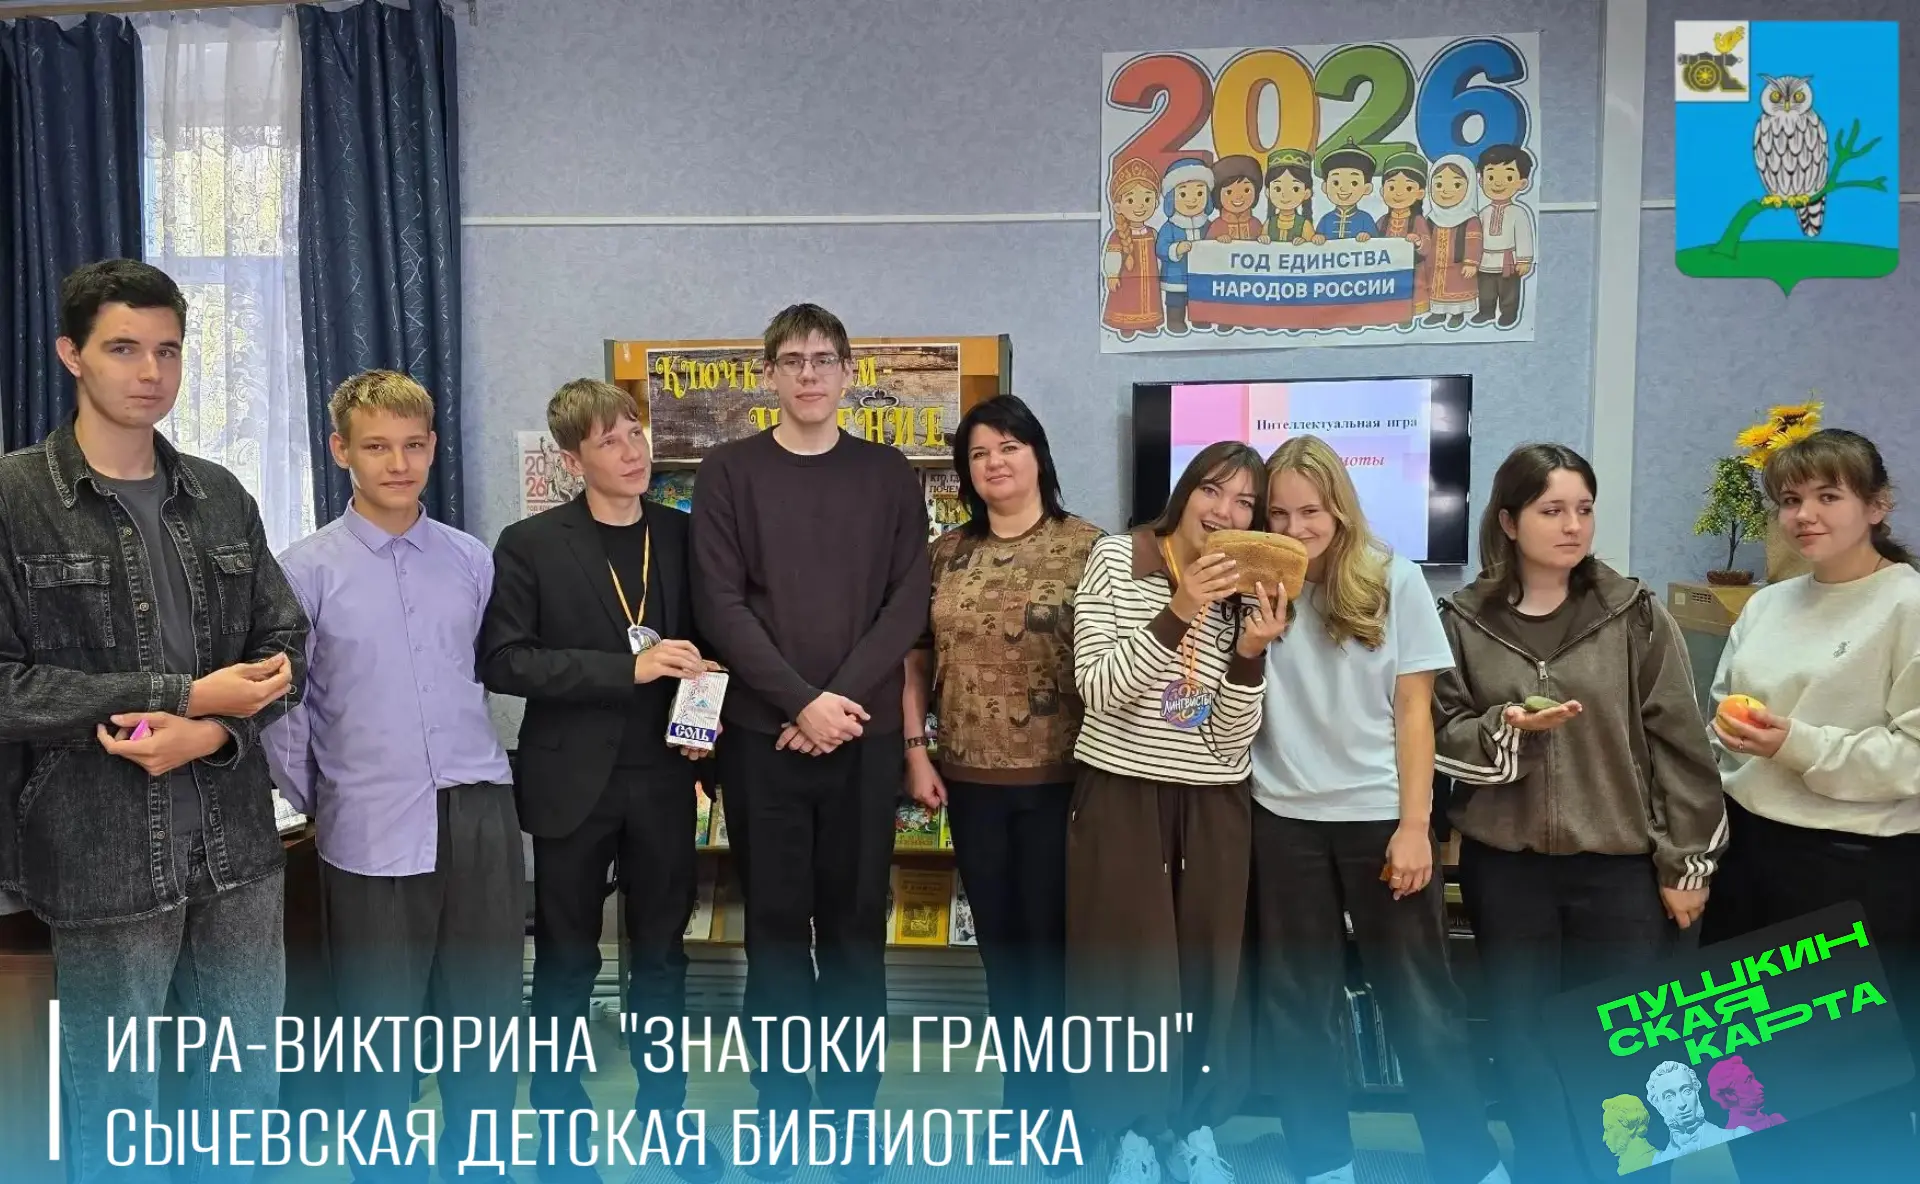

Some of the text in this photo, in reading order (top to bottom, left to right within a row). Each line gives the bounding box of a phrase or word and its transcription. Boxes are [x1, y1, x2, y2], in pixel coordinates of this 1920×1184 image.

[1109, 38, 1526, 178] 2026
[1230, 250, 1392, 273] ГОД ЕДИНСТВА
[1212, 278, 1395, 301] НАРОДОВ РОССИИ
[1256, 417, 1418, 432] Интеллектуальная игра
[524, 455, 546, 476] 20
[1338, 455, 1385, 467] моты
[524, 476, 547, 498] 26
[674, 724, 710, 741] СОЛЬ
